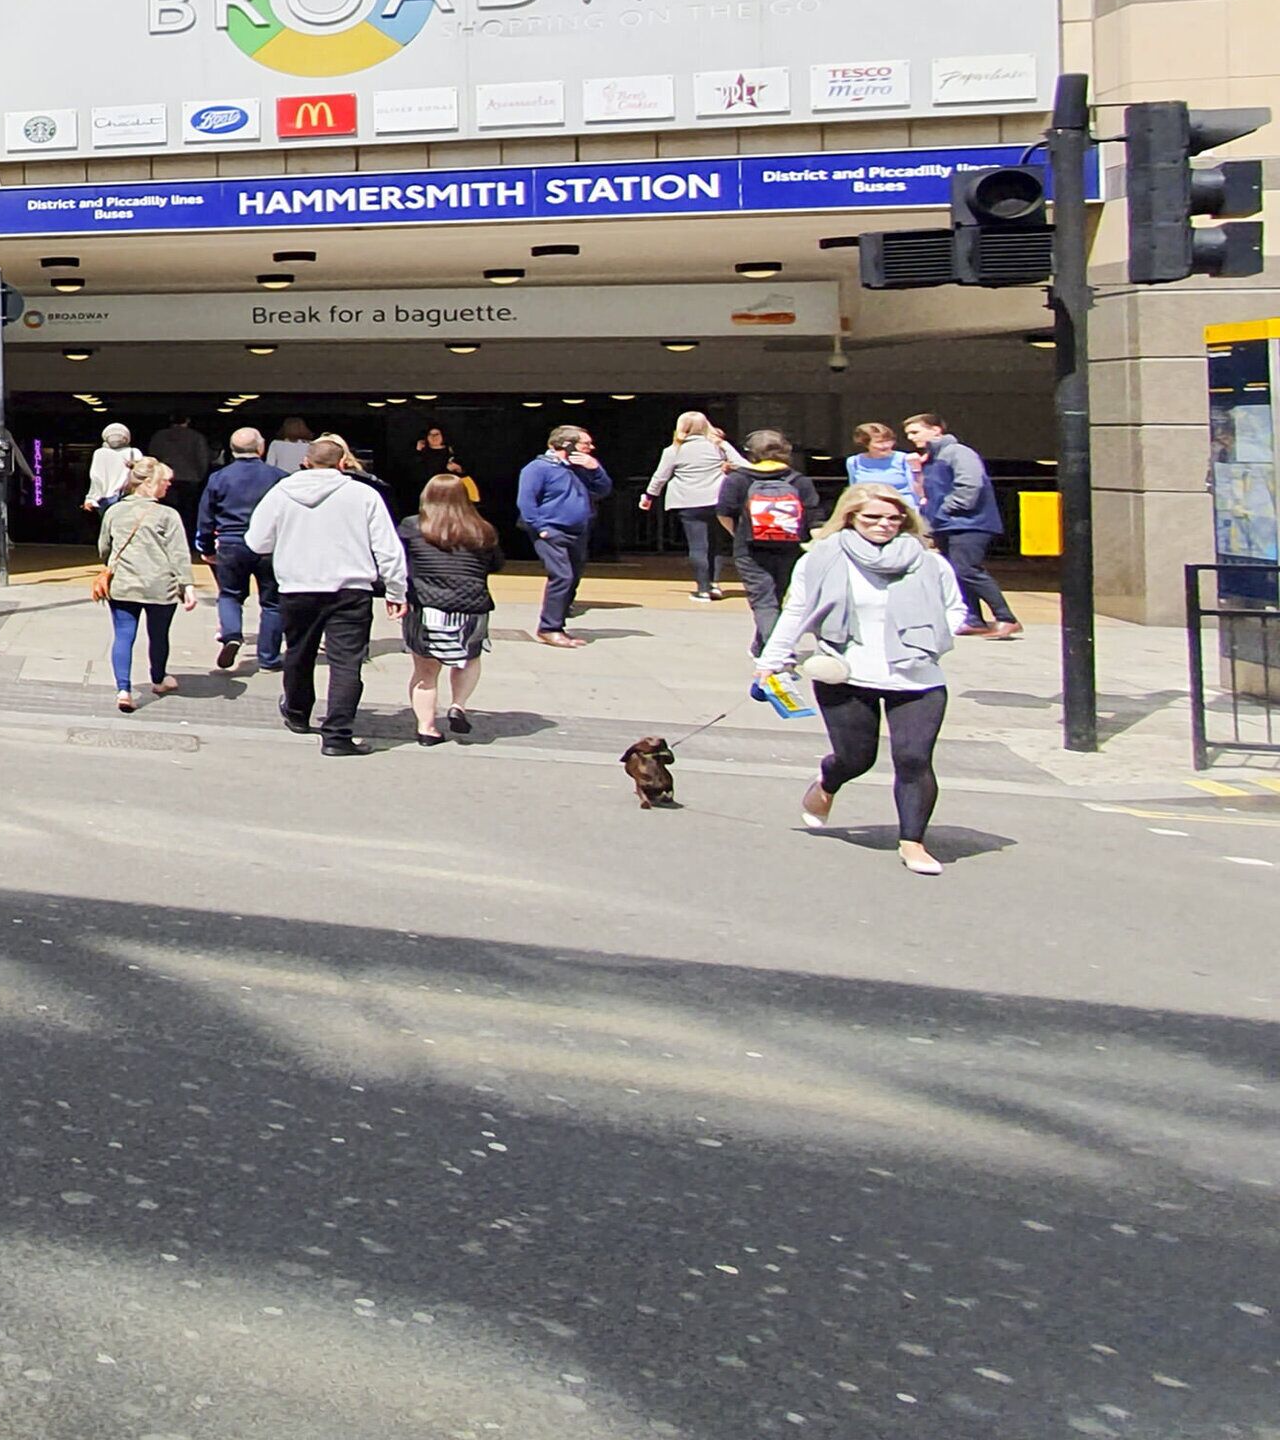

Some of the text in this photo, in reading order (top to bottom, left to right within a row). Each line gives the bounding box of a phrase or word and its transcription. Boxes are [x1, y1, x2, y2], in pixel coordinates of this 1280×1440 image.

[440, 12, 606, 40] SHOPPING
[619, 8, 671, 28] ON
[691, 1, 753, 22] THE
[828, 66, 892, 78] TESCO
[195, 109, 242, 130] Boots
[762, 169, 828, 183] District
[831, 167, 865, 180] and
[868, 164, 952, 179] Piccadilly
[238, 172, 720, 215] HAMMERSMITH STATION
[852, 180, 907, 193] Buses
[26, 194, 205, 211] District and Piccadilly lines
[94, 209, 134, 220] Buses
[47, 312, 110, 321] BROADWAY
[251, 304, 518, 327] Break for a baguette.
